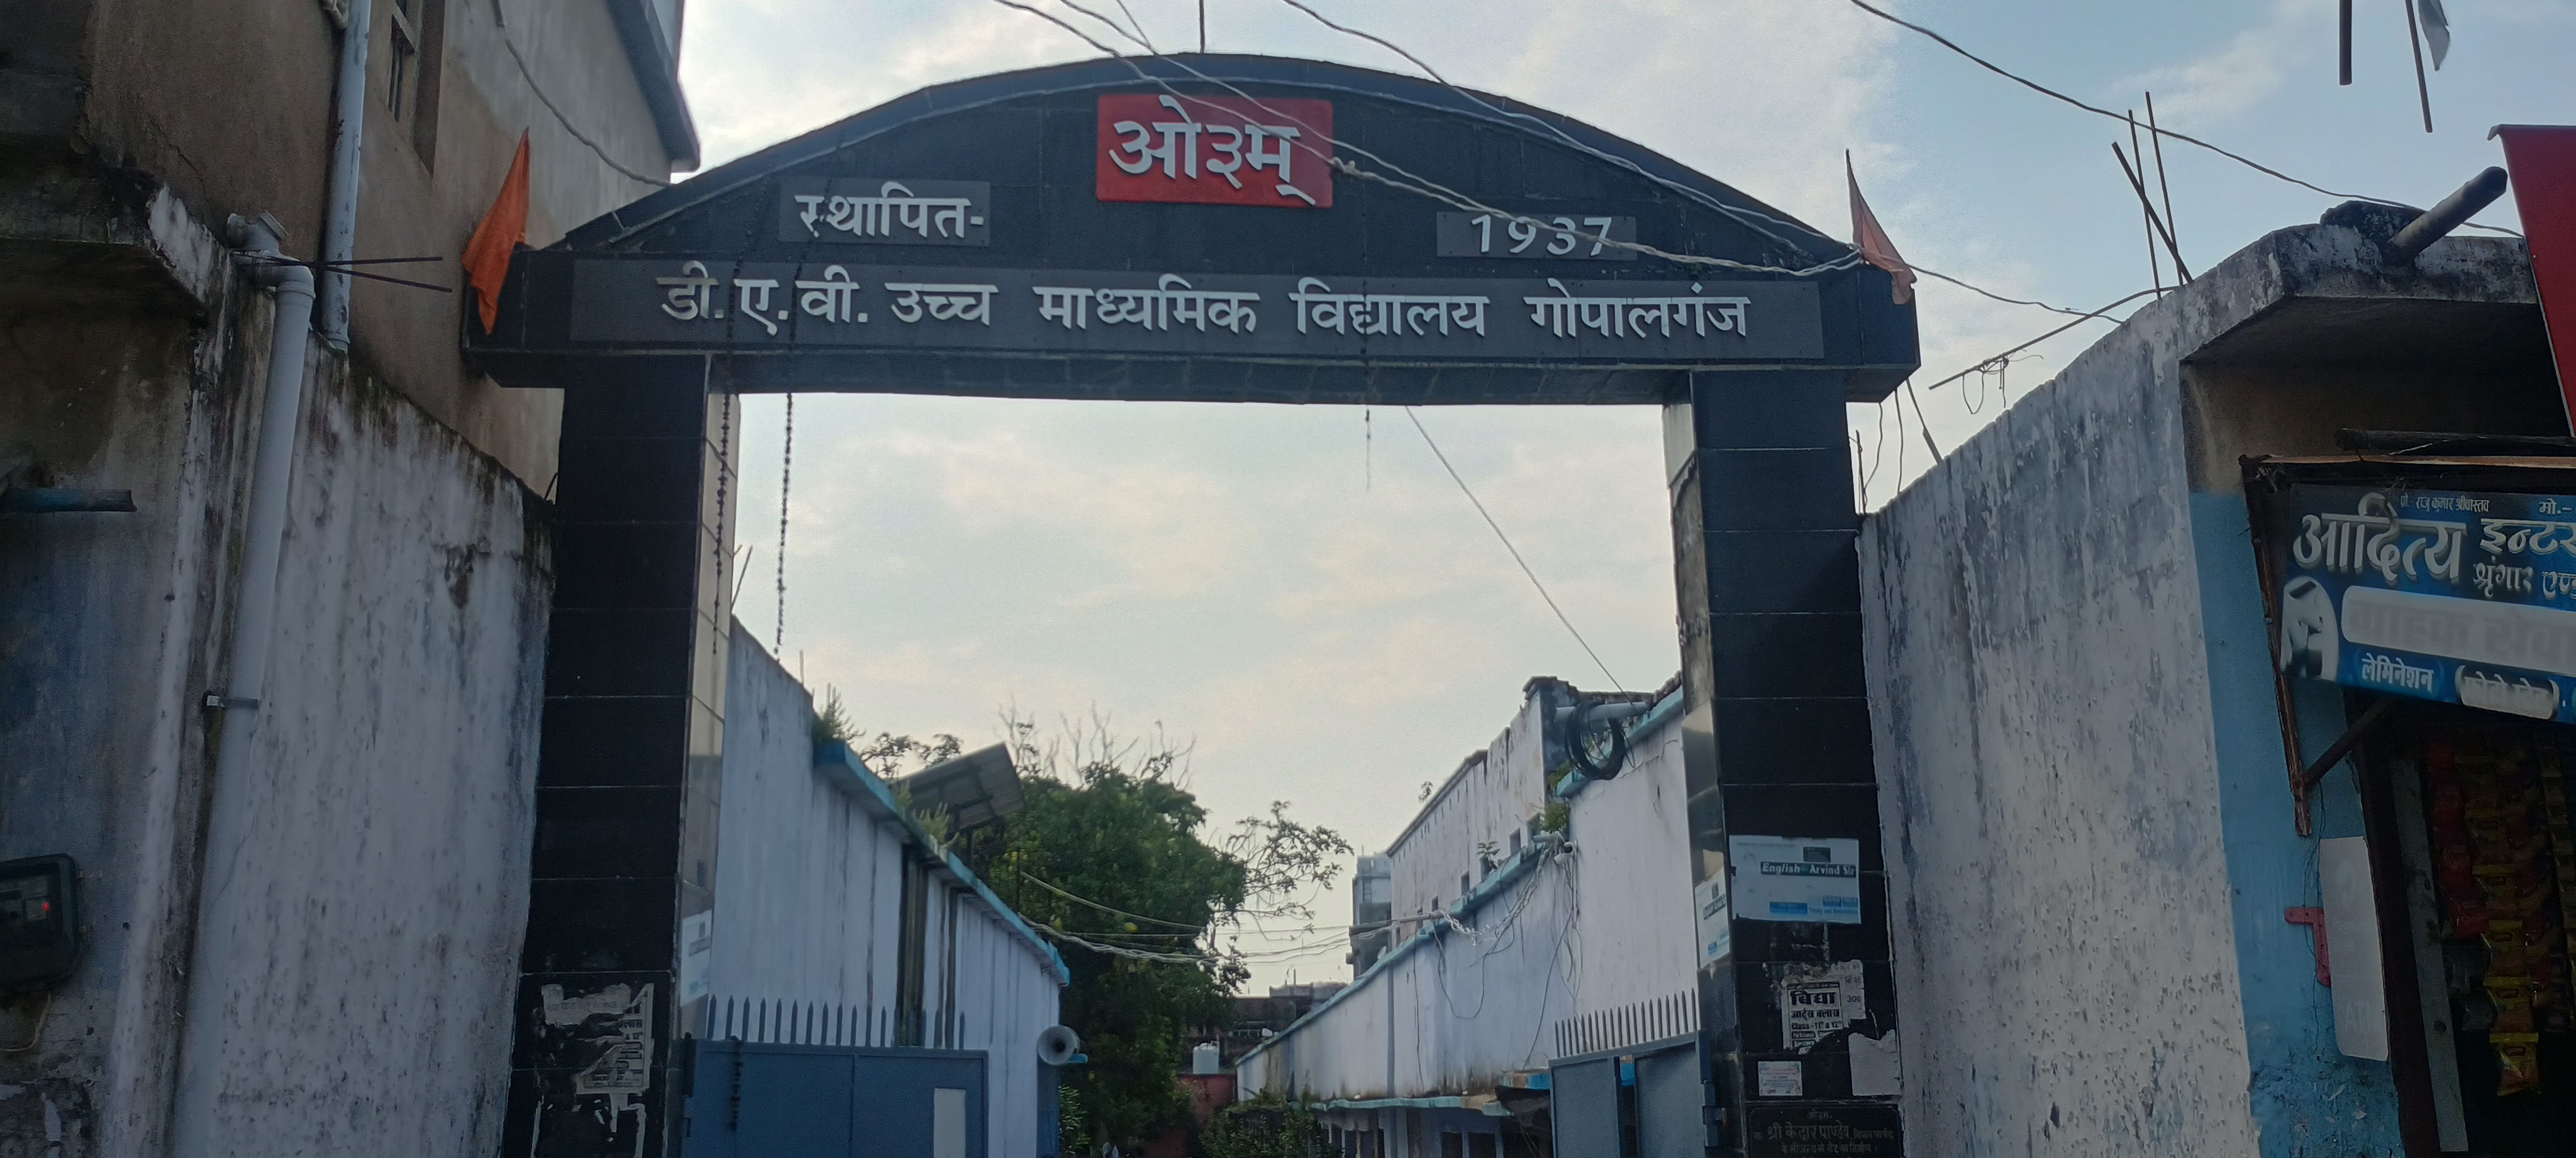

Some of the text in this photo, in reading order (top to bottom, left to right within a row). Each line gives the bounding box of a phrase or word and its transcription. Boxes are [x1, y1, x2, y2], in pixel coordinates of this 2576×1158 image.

[1471, 214, 1612, 256] 1937
[885, 282, 999, 325] उच्च
[1032, 273, 1260, 334] माध्यमिक
[1289, 277, 1490, 336] विद्यालय
[1524, 278, 1751, 338] गोपालगंज
[2431, 497, 2454, 513] कुमार
[2293, 492, 2467, 582] आदित्य
[2362, 653, 2434, 692] लेमिनेशन
[1762, 863, 1800, 875] English
[1809, 864, 1840, 874] Arvind
[1767, 1122, 1782, 1140] श्री
